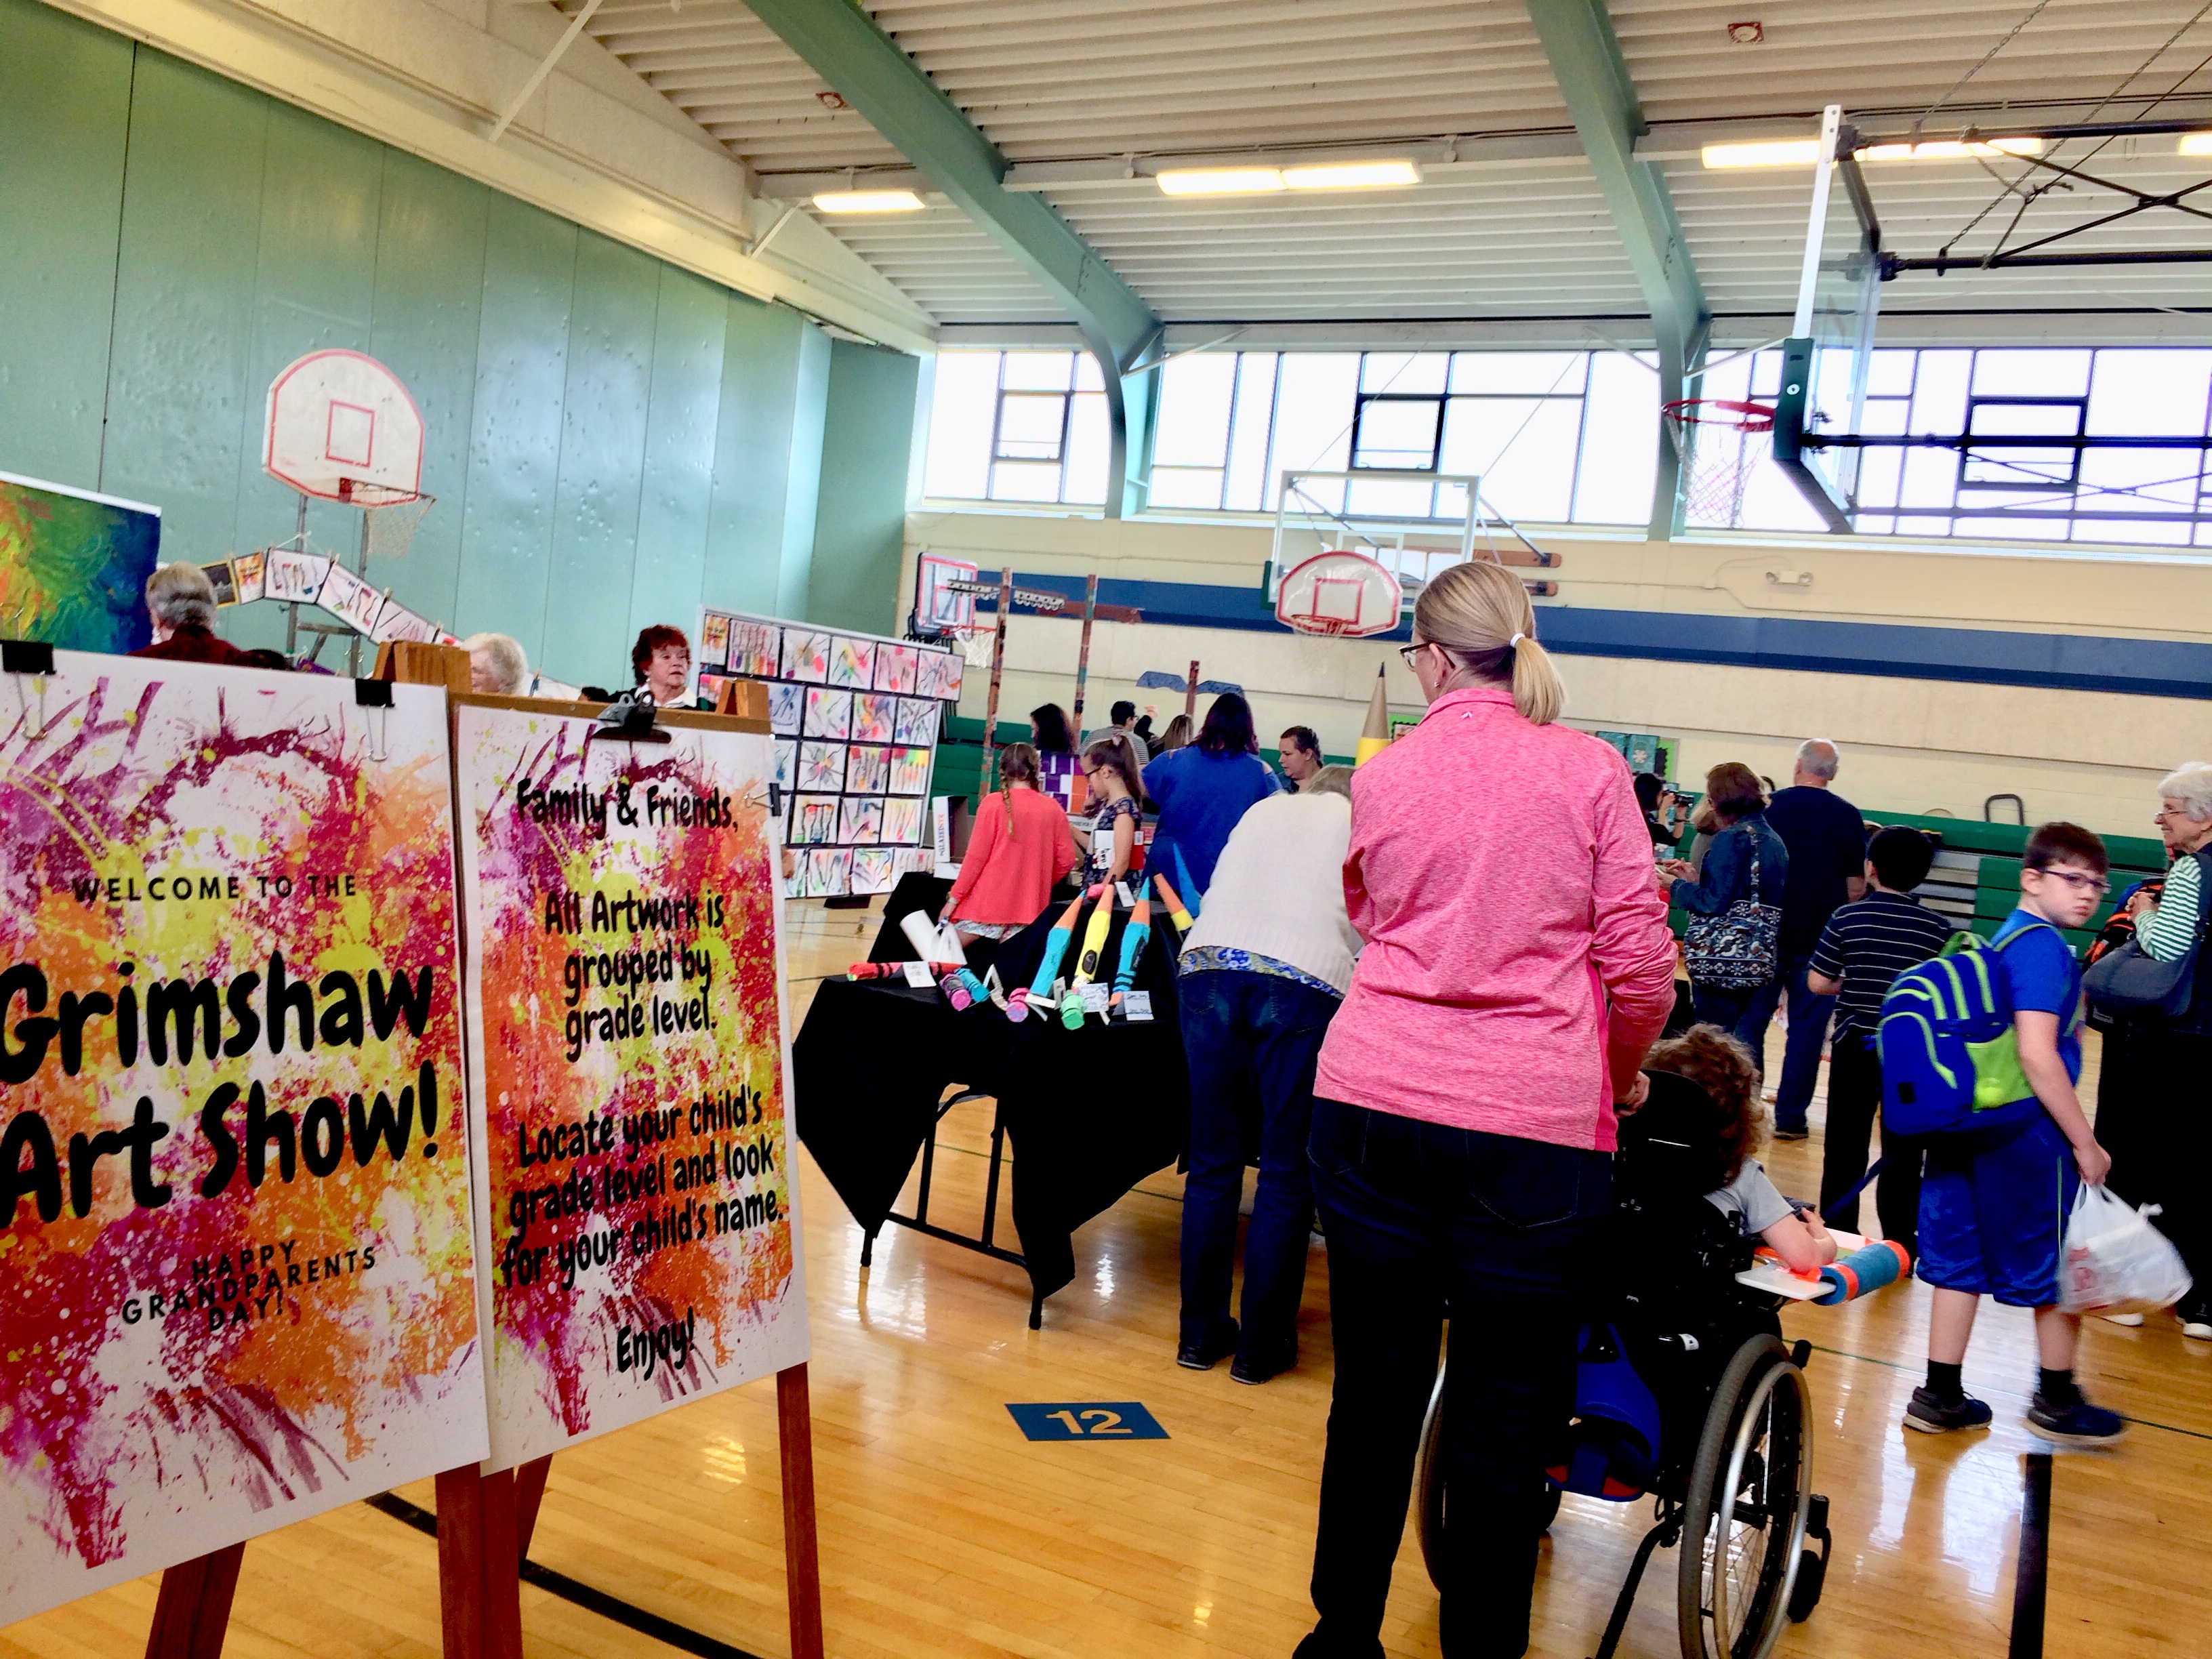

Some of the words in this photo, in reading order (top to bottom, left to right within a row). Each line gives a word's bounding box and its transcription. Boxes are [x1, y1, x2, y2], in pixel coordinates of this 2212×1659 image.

[516, 778, 607, 839] Family
[617, 783, 638, 825] &
[647, 785, 739, 832] Friends,
[73, 876, 240, 903] WELCOME
[258, 876, 293, 898] TO
[307, 875, 356, 897] THE
[545, 890, 581, 934] All
[592, 890, 699, 933] Artwork
[707, 889, 724, 928] is
[565, 940, 672, 1006] grouped
[681, 943, 711, 994] by
[0, 949, 433, 1084] Grimshaw
[565, 993, 645, 1063] grade
[653, 992, 716, 1036] level.
[0, 1096, 173, 1229] Art
[201, 1060, 438, 1200] Show!
[518, 1110, 614, 1168] Locate
[622, 1106, 683, 1162] your
[689, 1084, 762, 1136] child's
[510, 1167, 596, 1244] grade
[604, 1154, 665, 1206] level
[673, 1140, 716, 1191] and
[725, 1134, 774, 1179] look
[192, 1239, 297, 1284] HAPPY
[501, 1235, 550, 1288] for
[558, 1224, 625, 1292] your
[632, 1198, 708, 1257] child's
[715, 1189, 783, 1235] name.
[122, 1246, 376, 1325] GRANDPARENTS
[208, 1291, 283, 1334] DAY!
[617, 1306, 695, 1381] Enjoy!
[1046, 1409, 1133, 1434] 12
